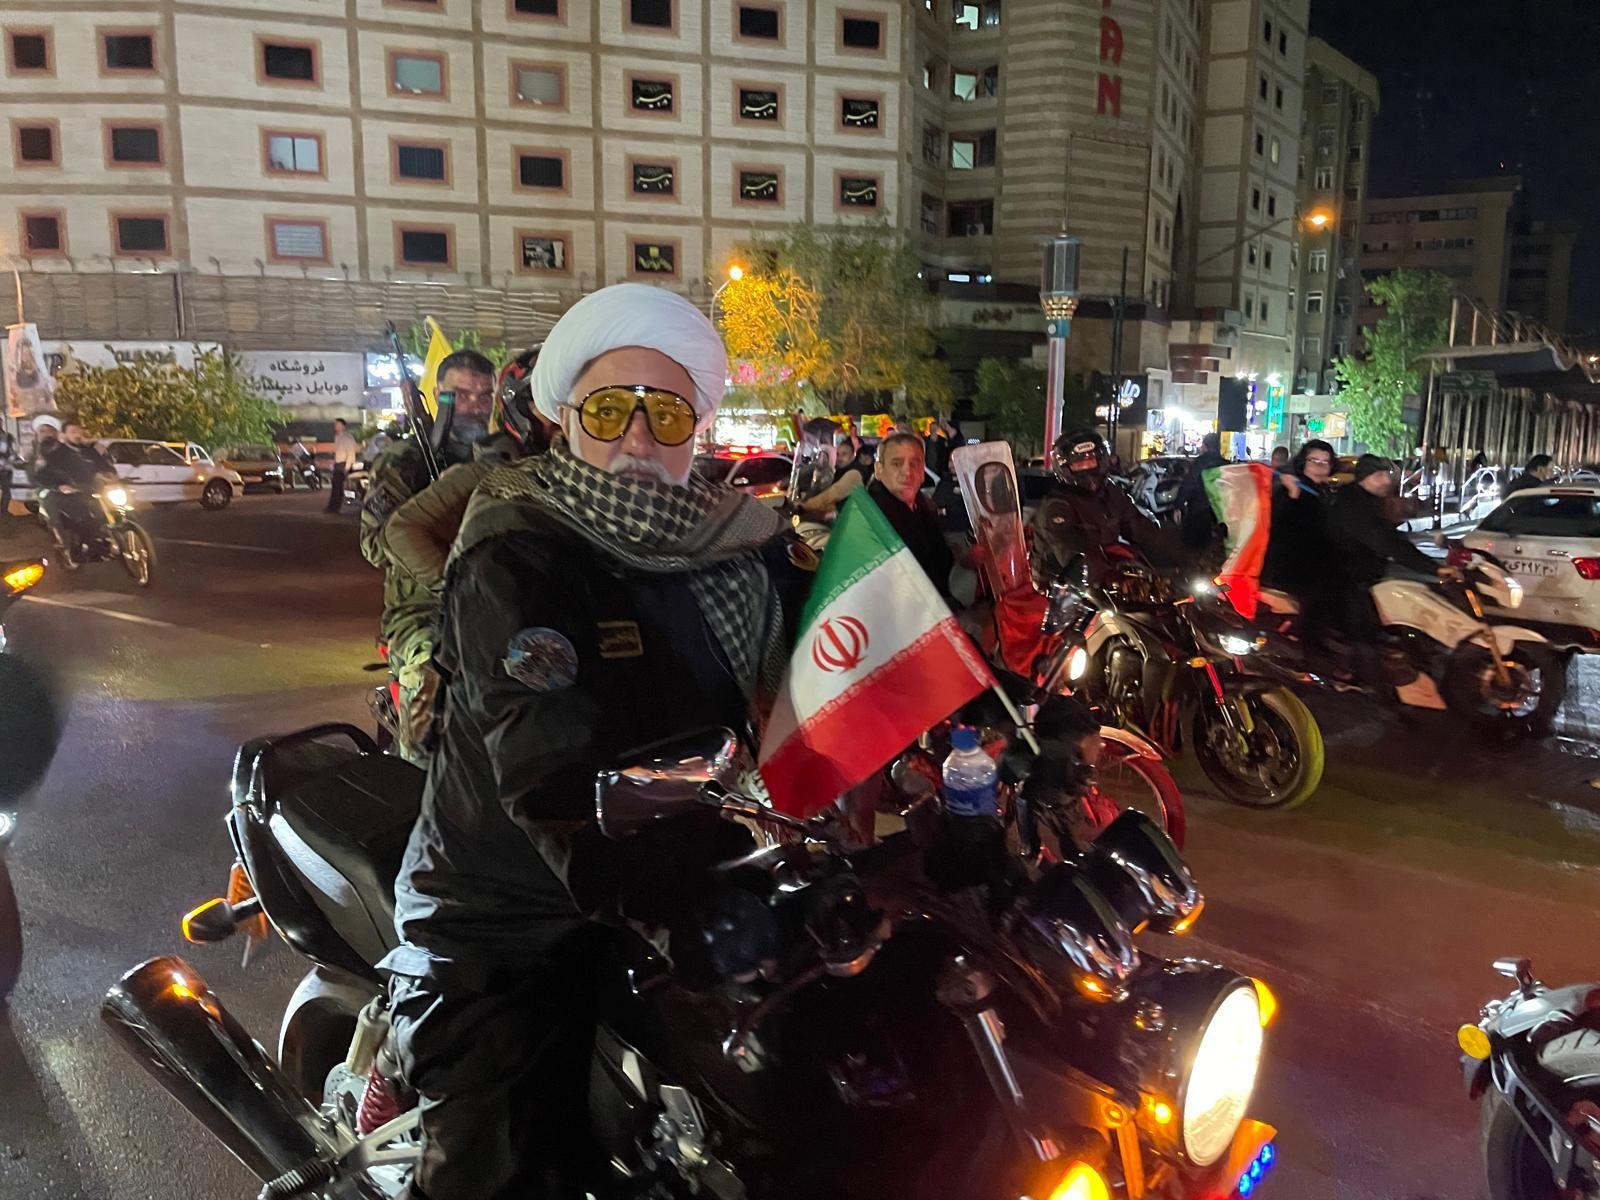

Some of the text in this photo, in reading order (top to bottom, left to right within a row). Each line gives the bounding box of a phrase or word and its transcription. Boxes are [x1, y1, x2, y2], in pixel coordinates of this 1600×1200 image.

[1097, 0, 1124, 117] AN
[269, 359, 325, 375] فروشگاه
[306, 380, 349, 395] موبایل
